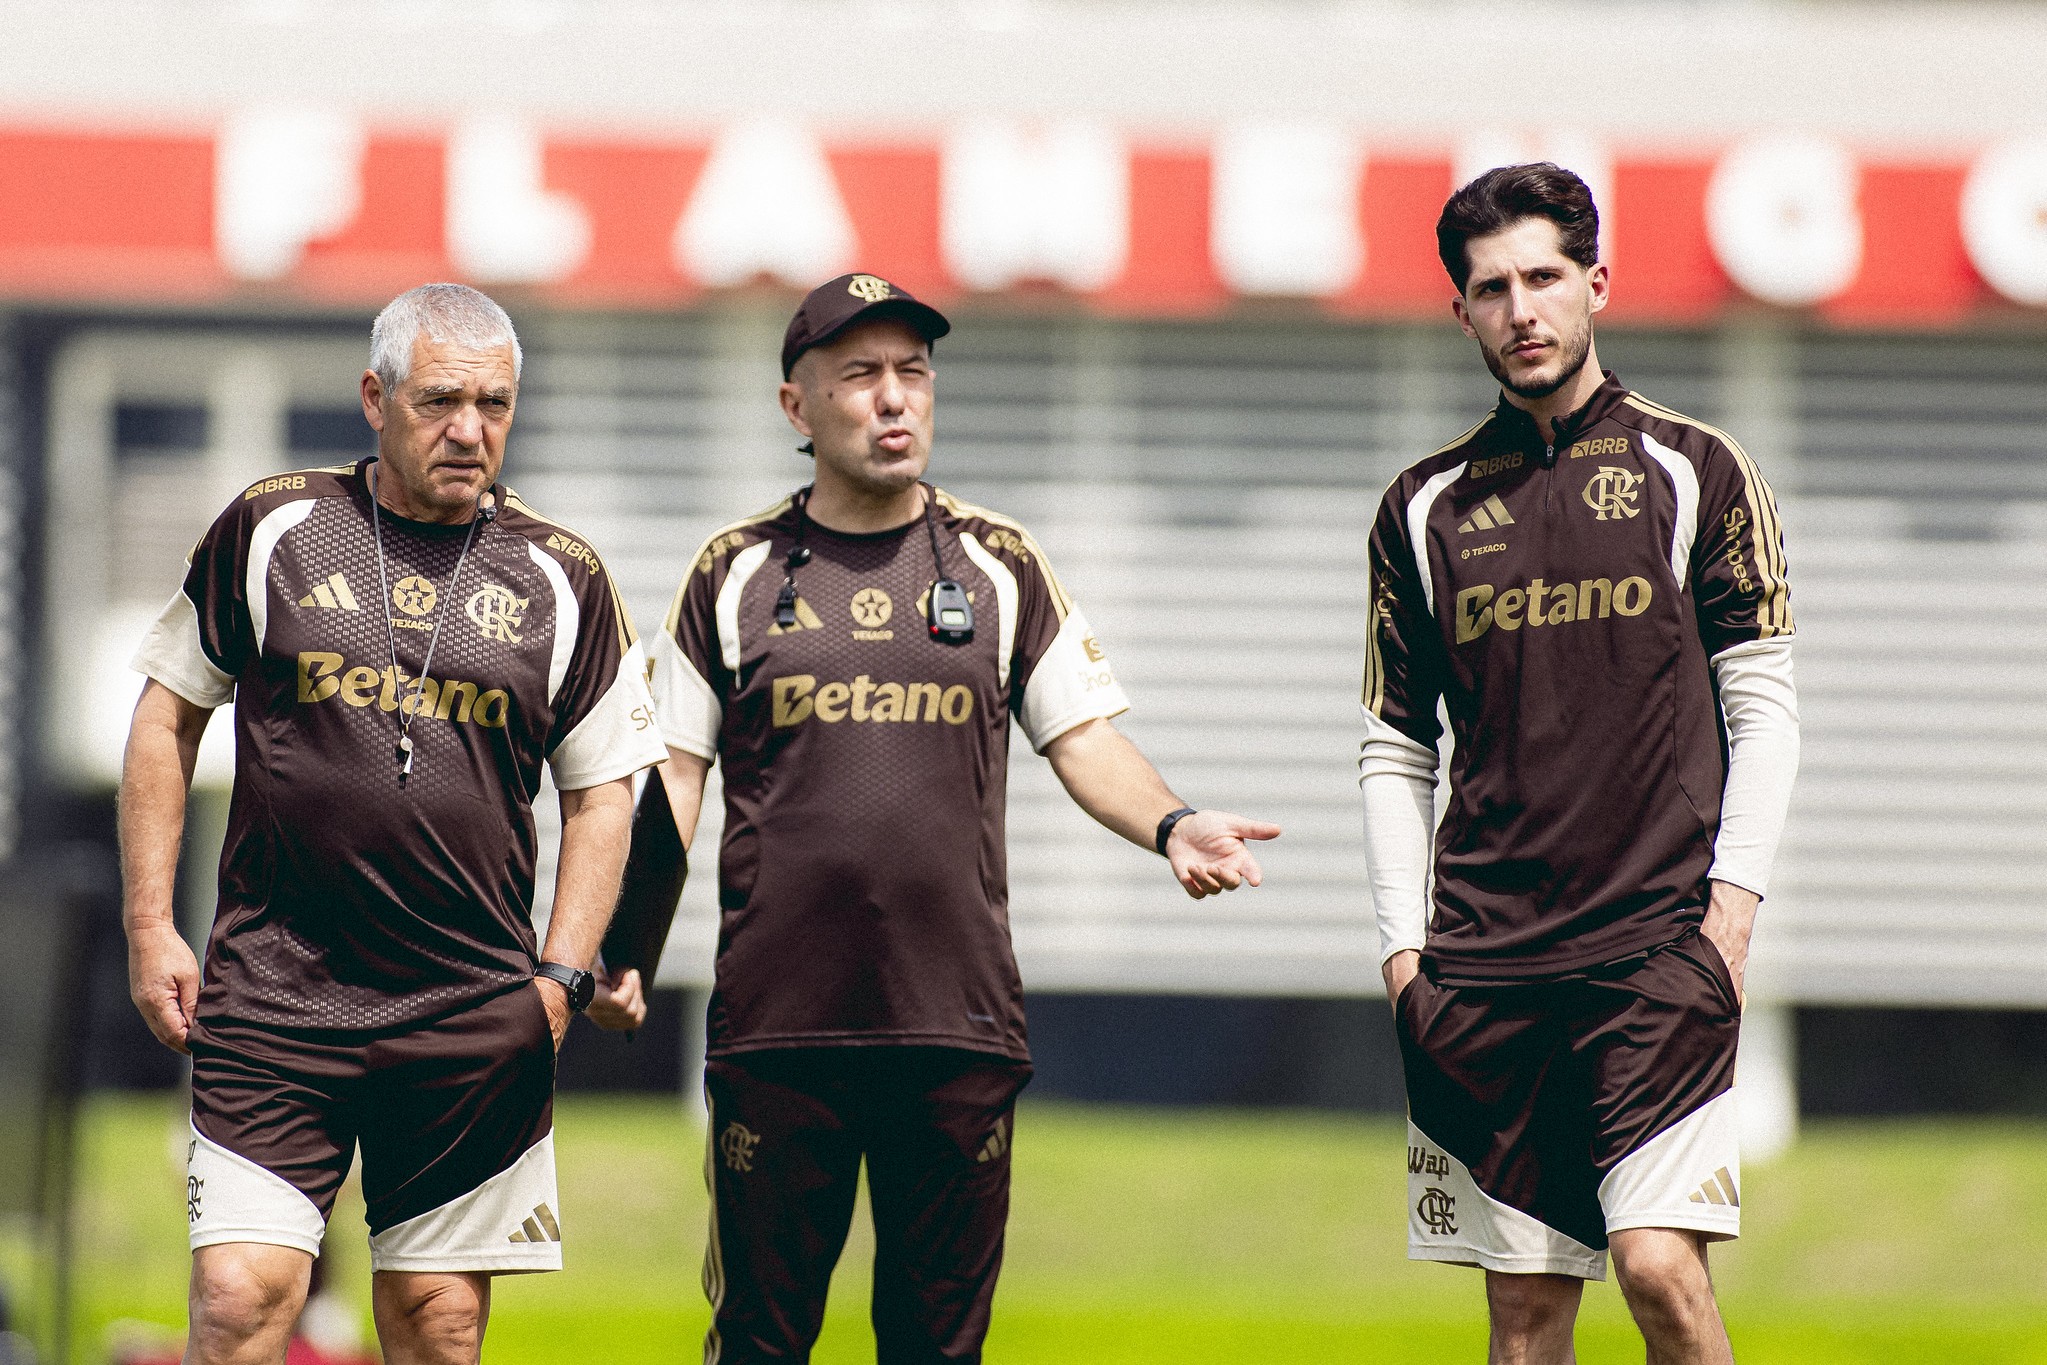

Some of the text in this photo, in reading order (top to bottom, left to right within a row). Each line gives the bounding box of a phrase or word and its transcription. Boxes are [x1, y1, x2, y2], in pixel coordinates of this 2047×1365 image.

[1589, 437, 1629, 456] BRB
[1488, 451, 1524, 475] BRB
[264, 475, 307, 494] BRB
[565, 540, 600, 576] BRB
[1471, 542, 1507, 556] TEXACO
[390, 618, 435, 632] TEXACO
[1455, 576, 1653, 644] Betano
[297, 650, 510, 729] Betano
[772, 674, 974, 728] Betano
[1407, 1145, 1450, 1182] Wap
